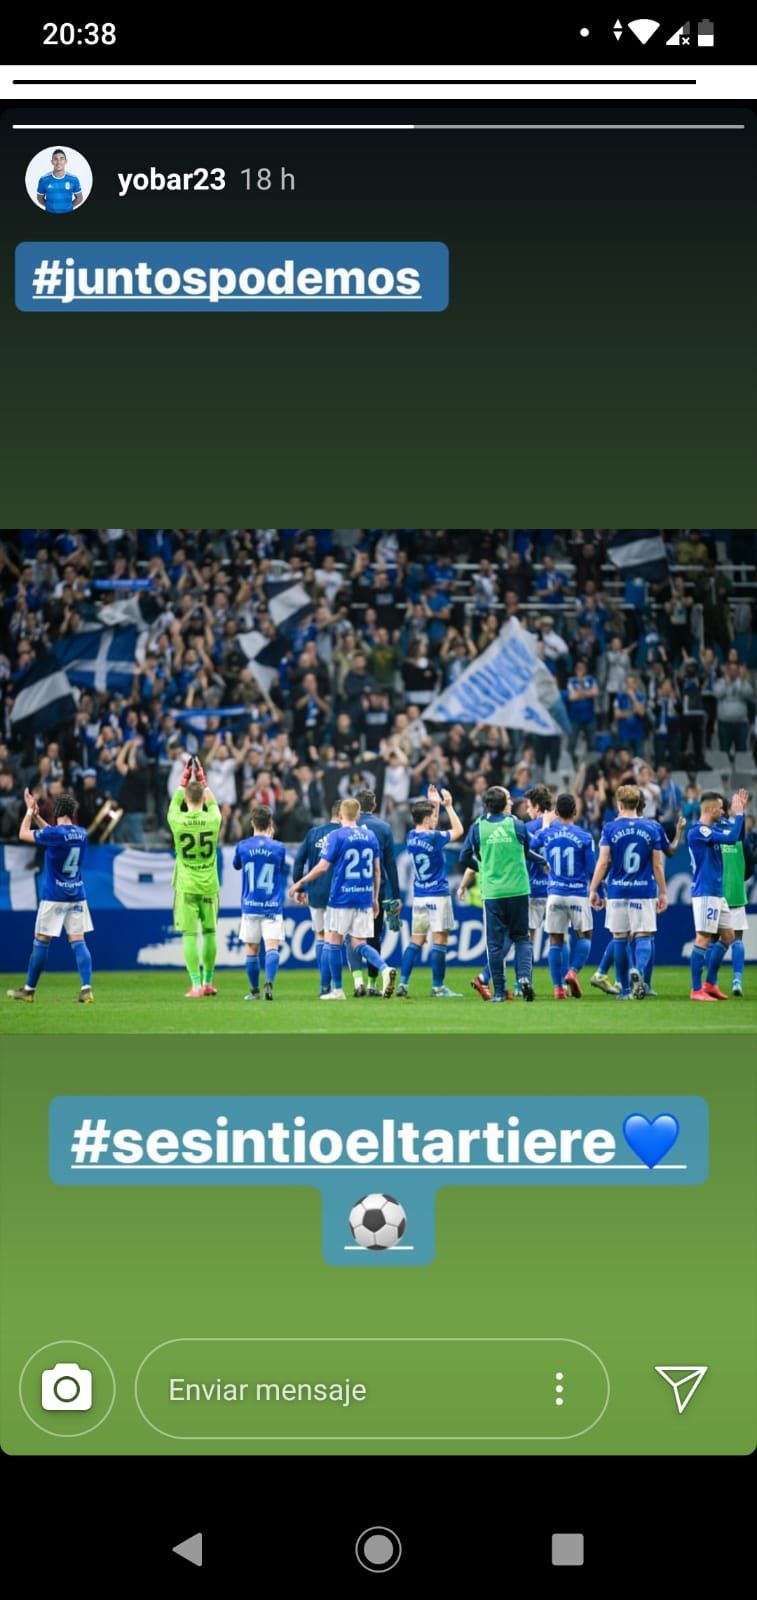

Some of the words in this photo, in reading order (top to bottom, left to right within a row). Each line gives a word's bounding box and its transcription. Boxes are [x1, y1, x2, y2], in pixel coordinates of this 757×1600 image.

[179, 832, 213, 859] 25
[549, 846, 575, 877] 11
[623, 842, 641, 874] 6
[62, 846, 81, 878] 4
[244, 861, 276, 895] 14
[344, 848, 374, 880] 23
[706, 907, 719, 921] 20
